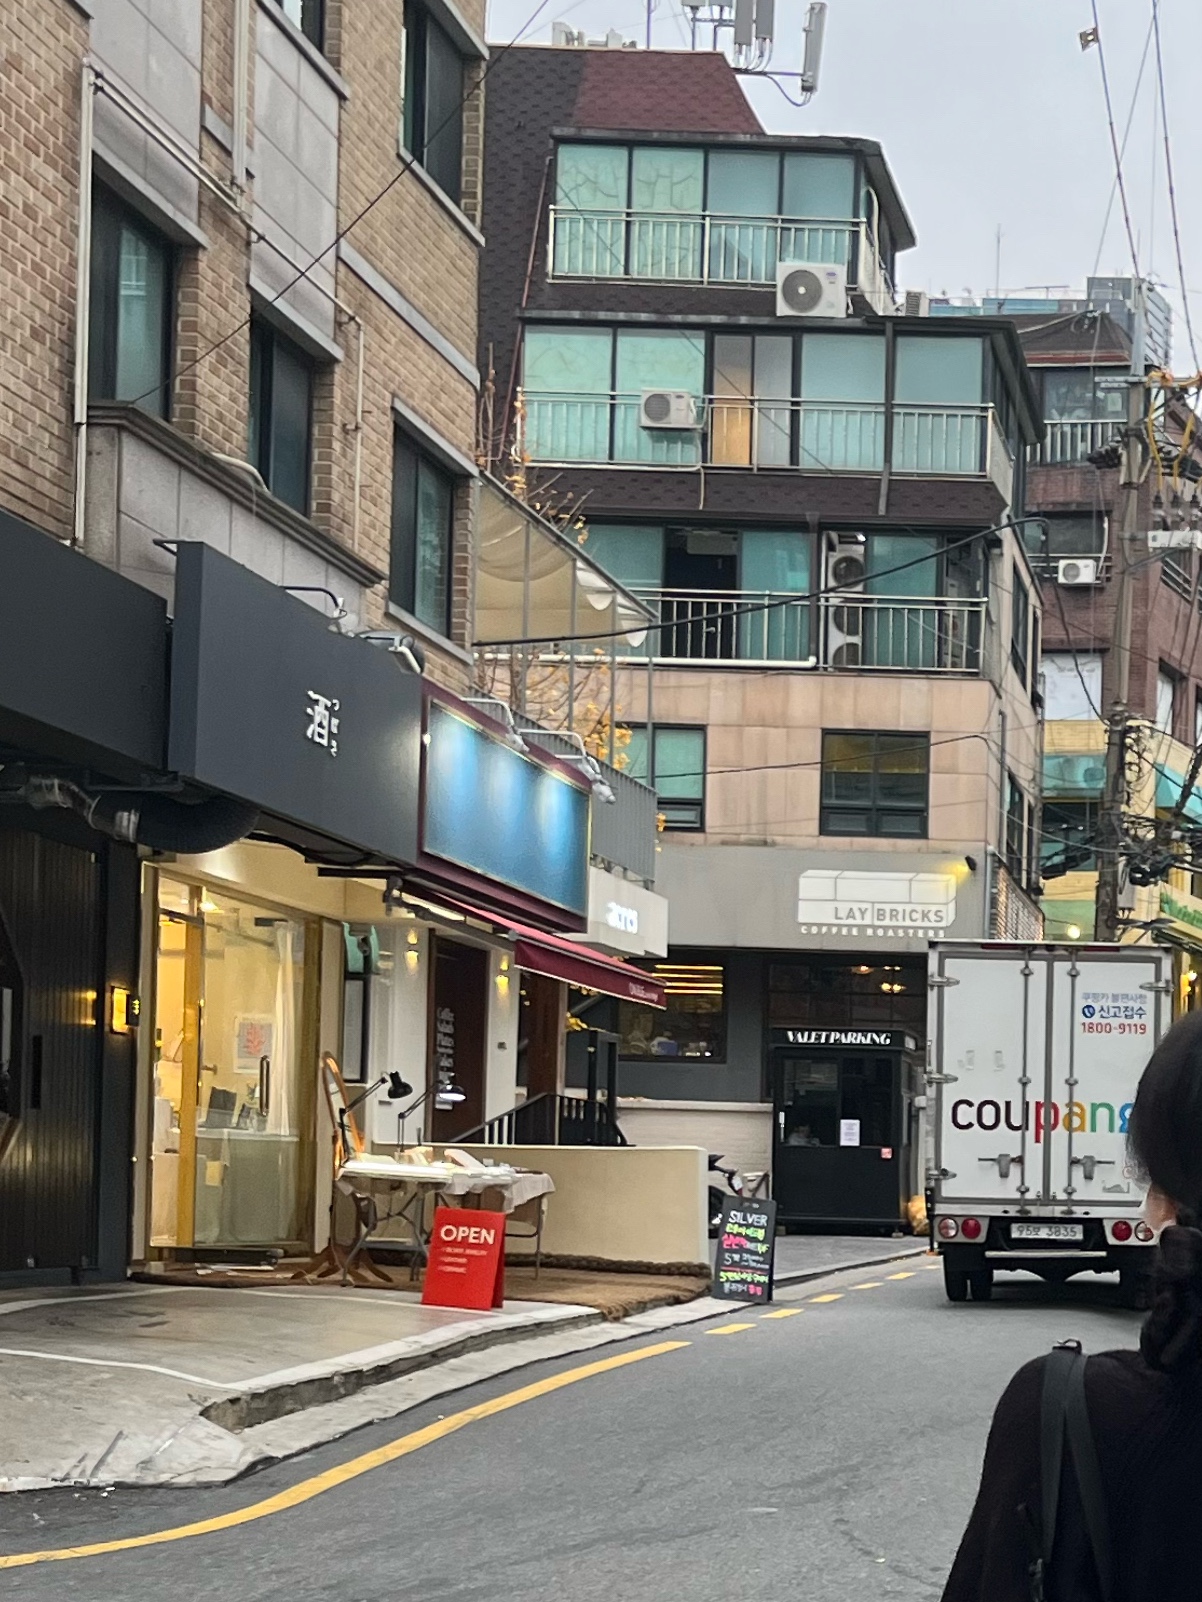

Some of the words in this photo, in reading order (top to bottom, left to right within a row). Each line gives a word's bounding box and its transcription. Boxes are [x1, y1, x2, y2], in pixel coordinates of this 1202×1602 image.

[834, 906, 869, 921] LAY
[876, 908, 944, 923] BRICKS
[801, 925, 859, 936] COFFEE
[866, 928, 945, 938] ROASTERS
[1098, 1005, 1147, 1019] 신고접수
[1081, 1022, 1147, 1035] 1800-9119
[787, 1031, 829, 1044] VALET
[828, 1031, 892, 1045] PARKING
[728, 1210, 768, 1226] SILVER
[440, 1225, 496, 1245] OPEN
